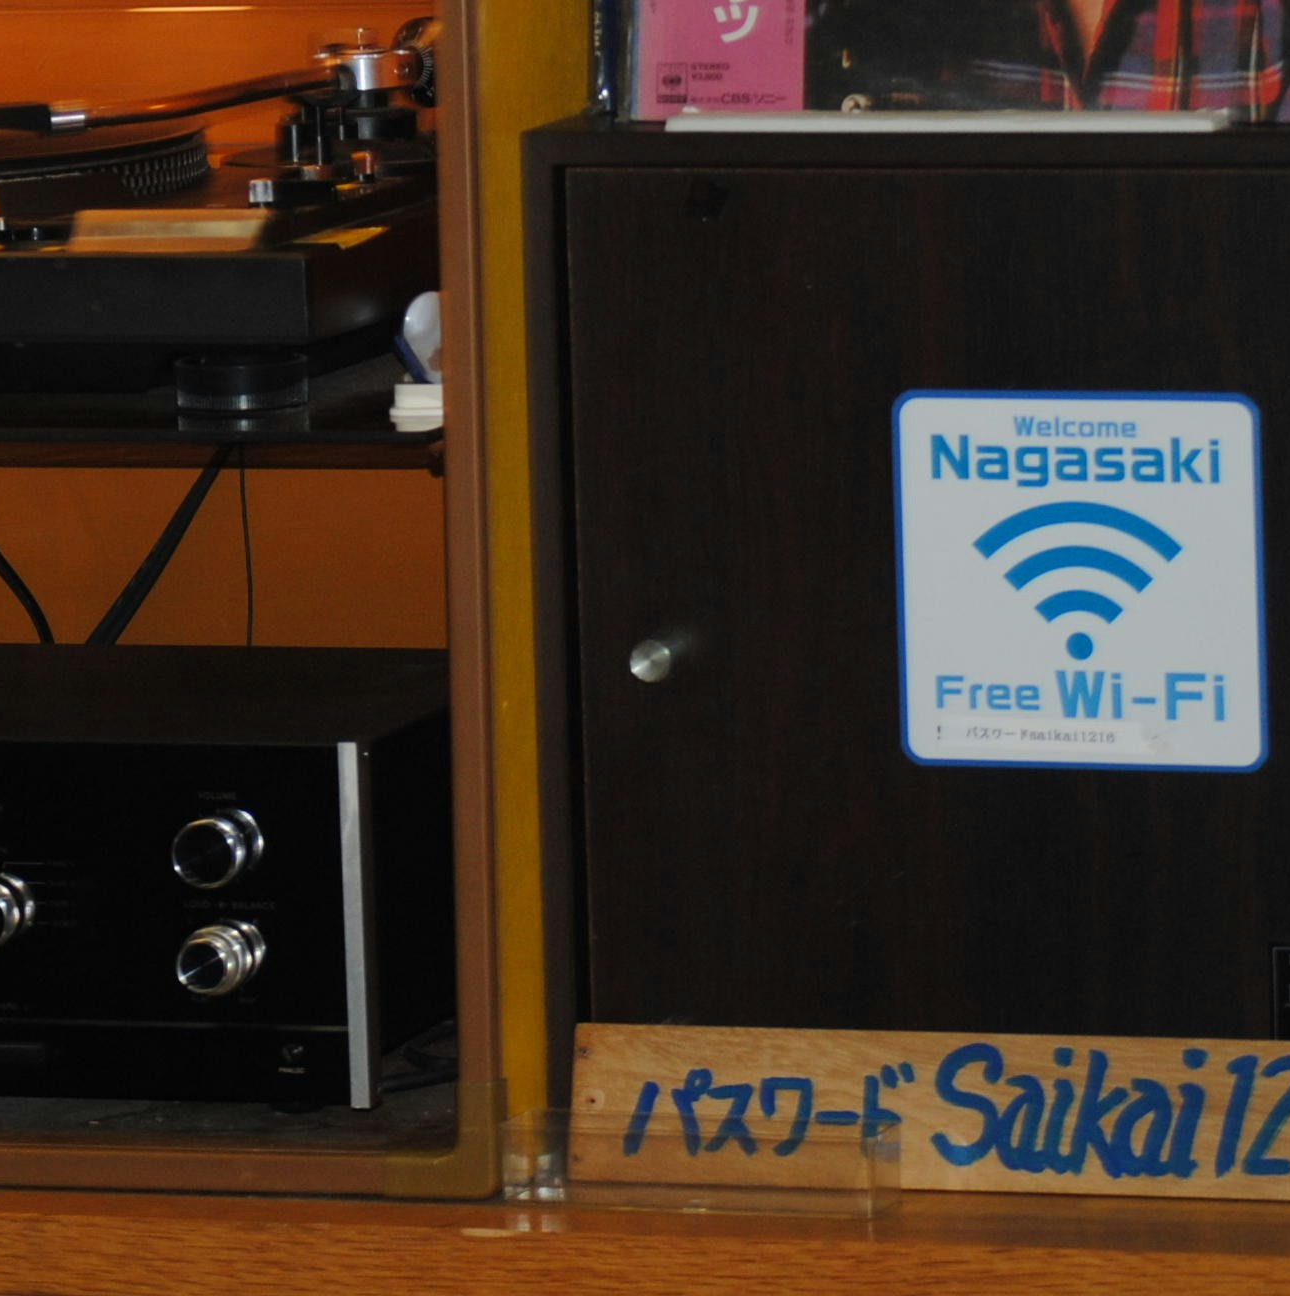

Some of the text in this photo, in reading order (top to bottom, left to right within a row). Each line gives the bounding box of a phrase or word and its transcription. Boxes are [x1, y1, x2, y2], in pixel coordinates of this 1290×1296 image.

[1013, 416, 1137, 438] Welcome
[930, 434, 1220, 488] Nagasaki
[935, 669, 1226, 722] Free Wi-Fi
[623, 1061, 915, 1157] パスワード
